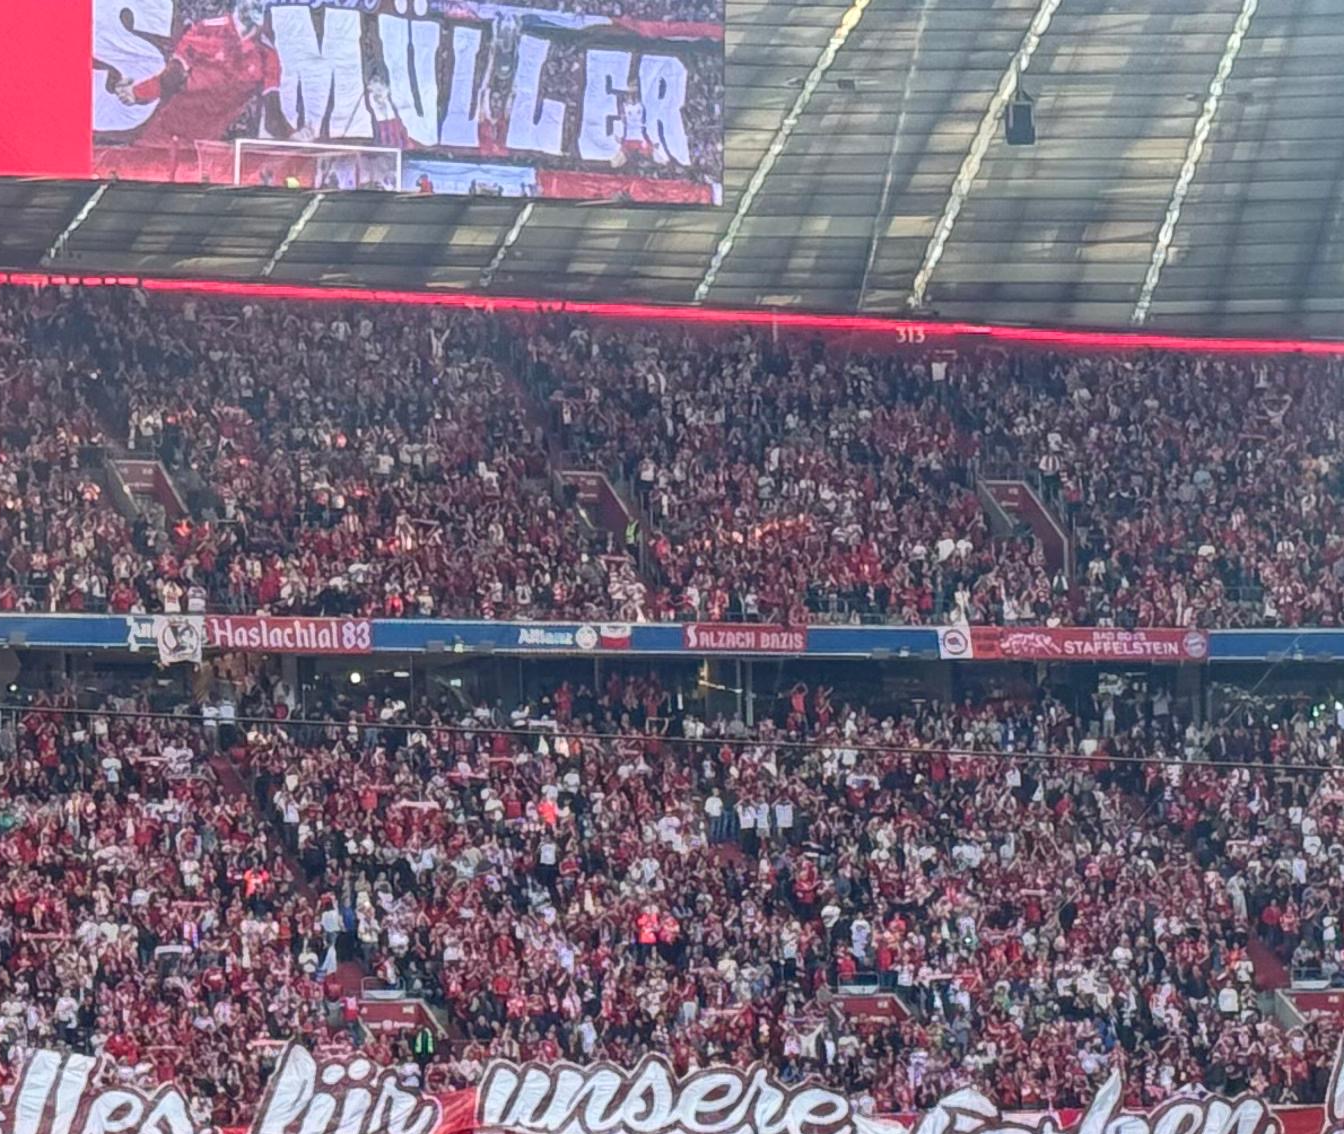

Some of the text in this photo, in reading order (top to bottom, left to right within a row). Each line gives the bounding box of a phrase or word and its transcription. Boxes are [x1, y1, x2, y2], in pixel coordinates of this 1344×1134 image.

[895, 325, 926, 343] 313
[212, 618, 371, 650] Haslachtal 83
[518, 628, 574, 645] Allianz
[1064, 641, 1179, 656] STAFFELSTEIN
